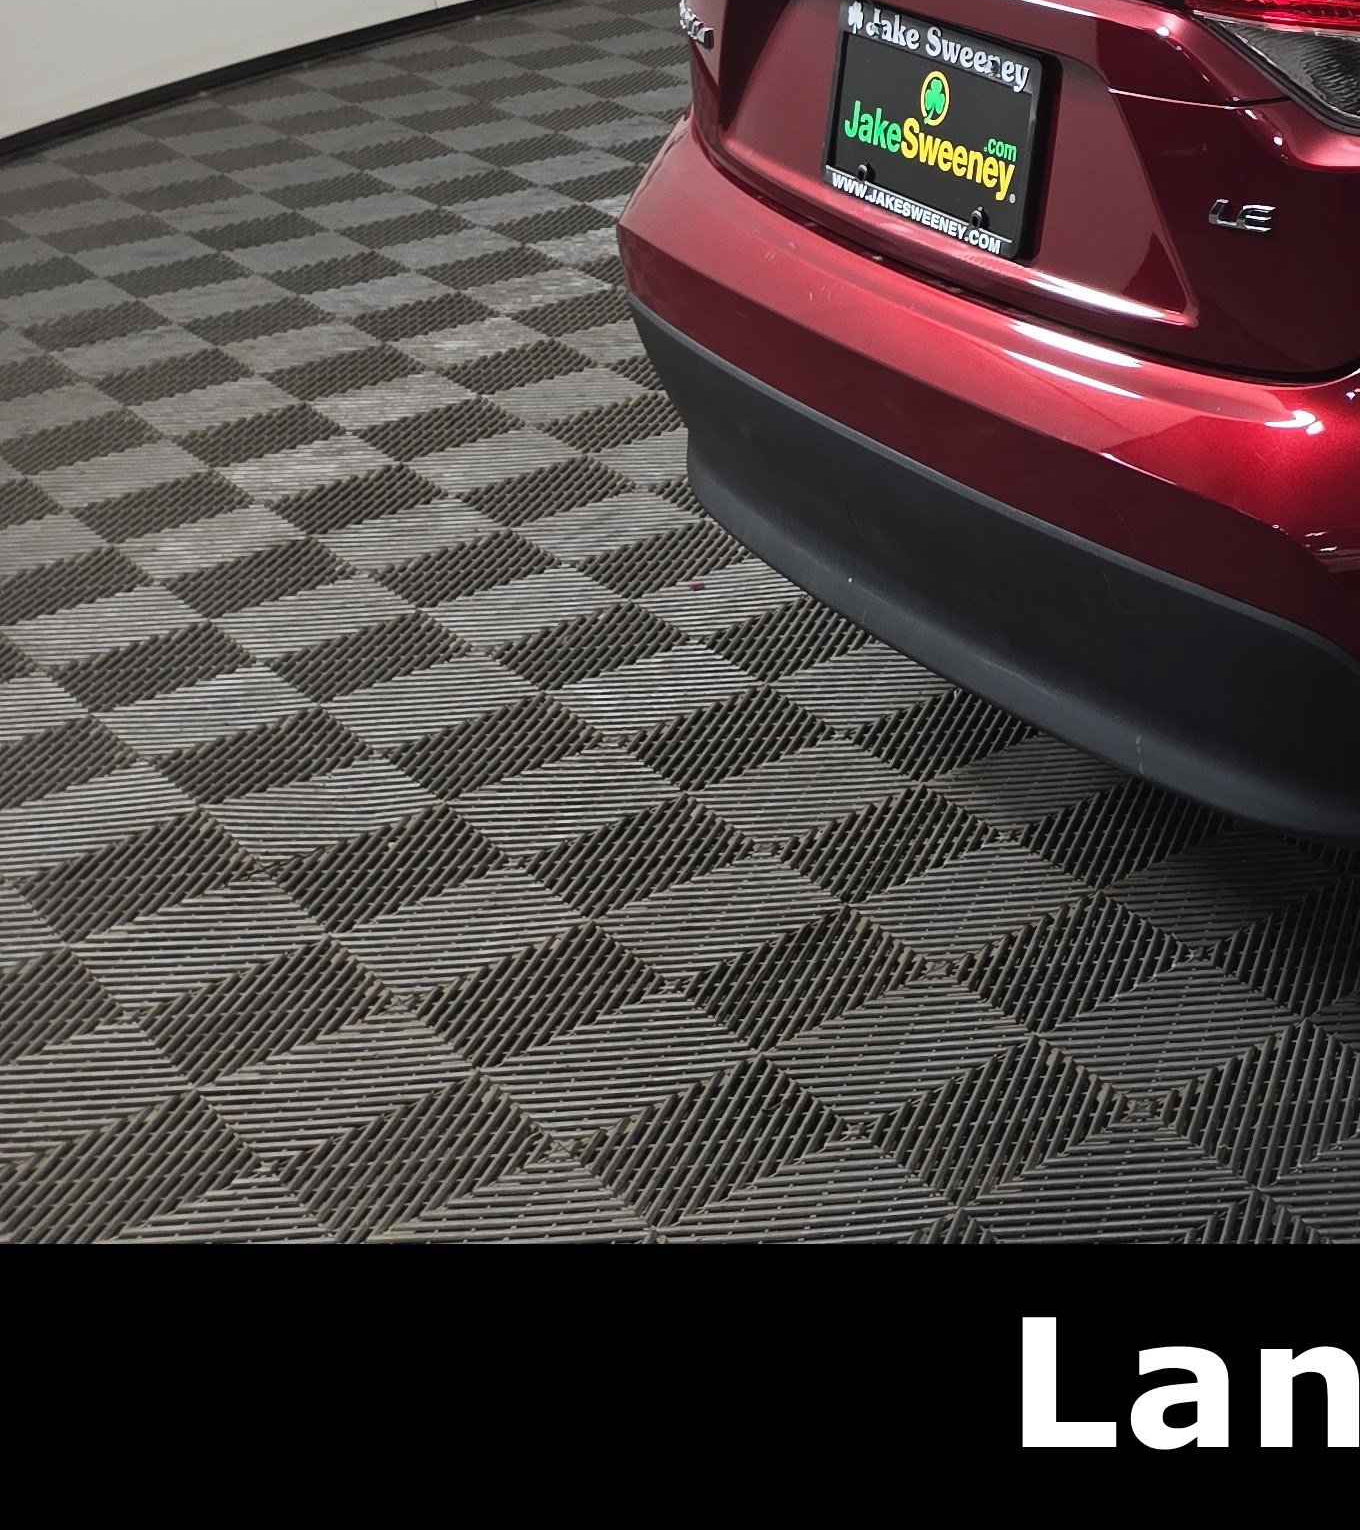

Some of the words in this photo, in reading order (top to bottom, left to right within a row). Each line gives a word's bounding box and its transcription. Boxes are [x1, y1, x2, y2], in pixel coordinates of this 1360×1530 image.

[866, 8, 920, 50] Jake
[925, 26, 1029, 93] Sweeney
[832, 173, 1002, 254] WWW.JAKESWEENEY.COM
[1208, 198, 1276, 233] LE
